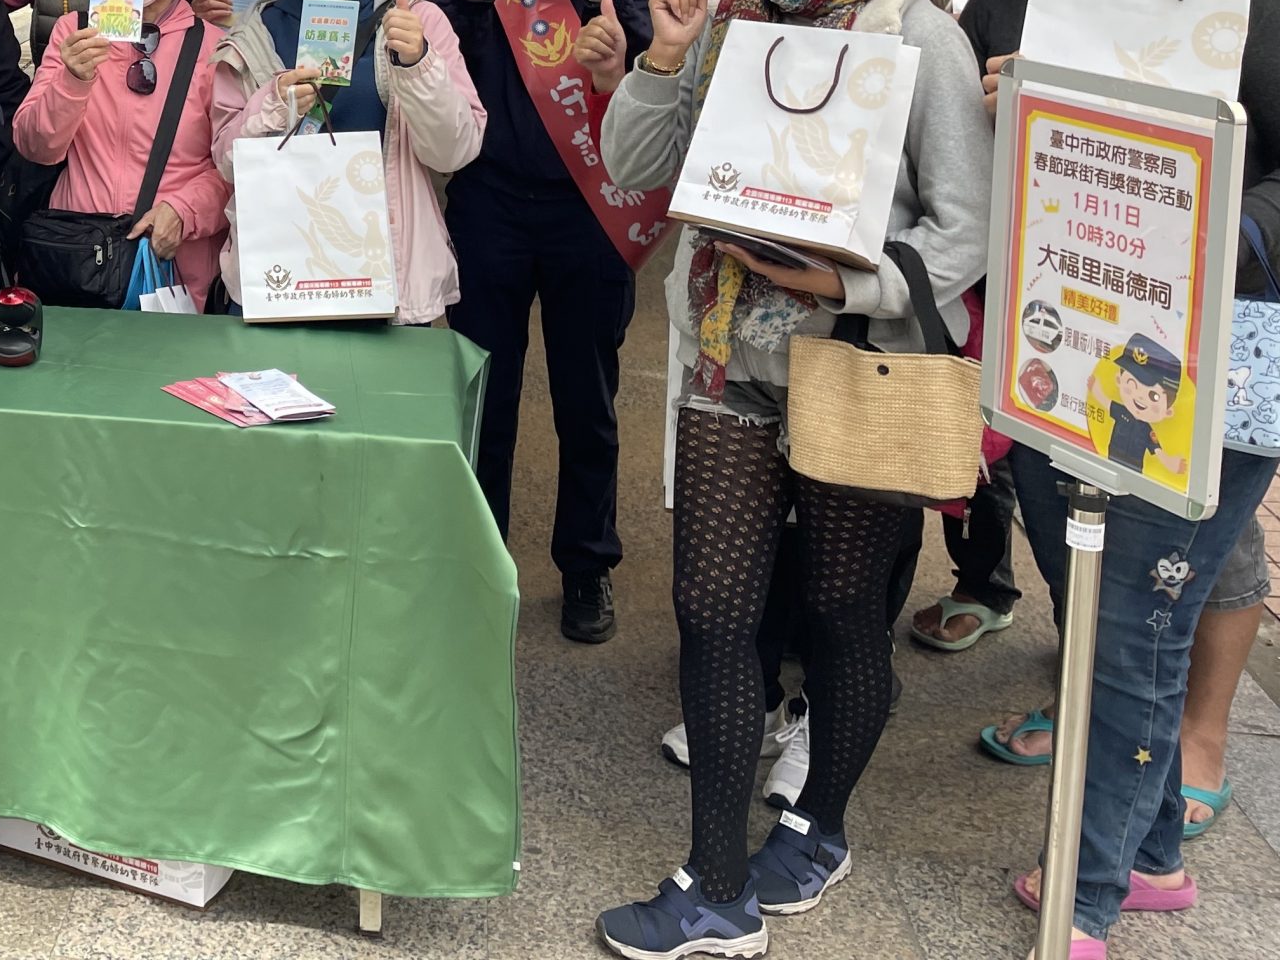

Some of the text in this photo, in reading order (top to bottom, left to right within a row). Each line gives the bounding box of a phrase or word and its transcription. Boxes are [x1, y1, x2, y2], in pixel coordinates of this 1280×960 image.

[1050, 129, 1177, 178] 臺中市政府警察局
[1034, 151, 1193, 211] 春節踩街有獎徵答活動
[1073, 192, 1140, 228] 1月11日
[1066, 220, 1146, 259] 10時30分
[1038, 244, 1172, 310] 大福里福德祠
[1064, 290, 1118, 321] 精美好禮
